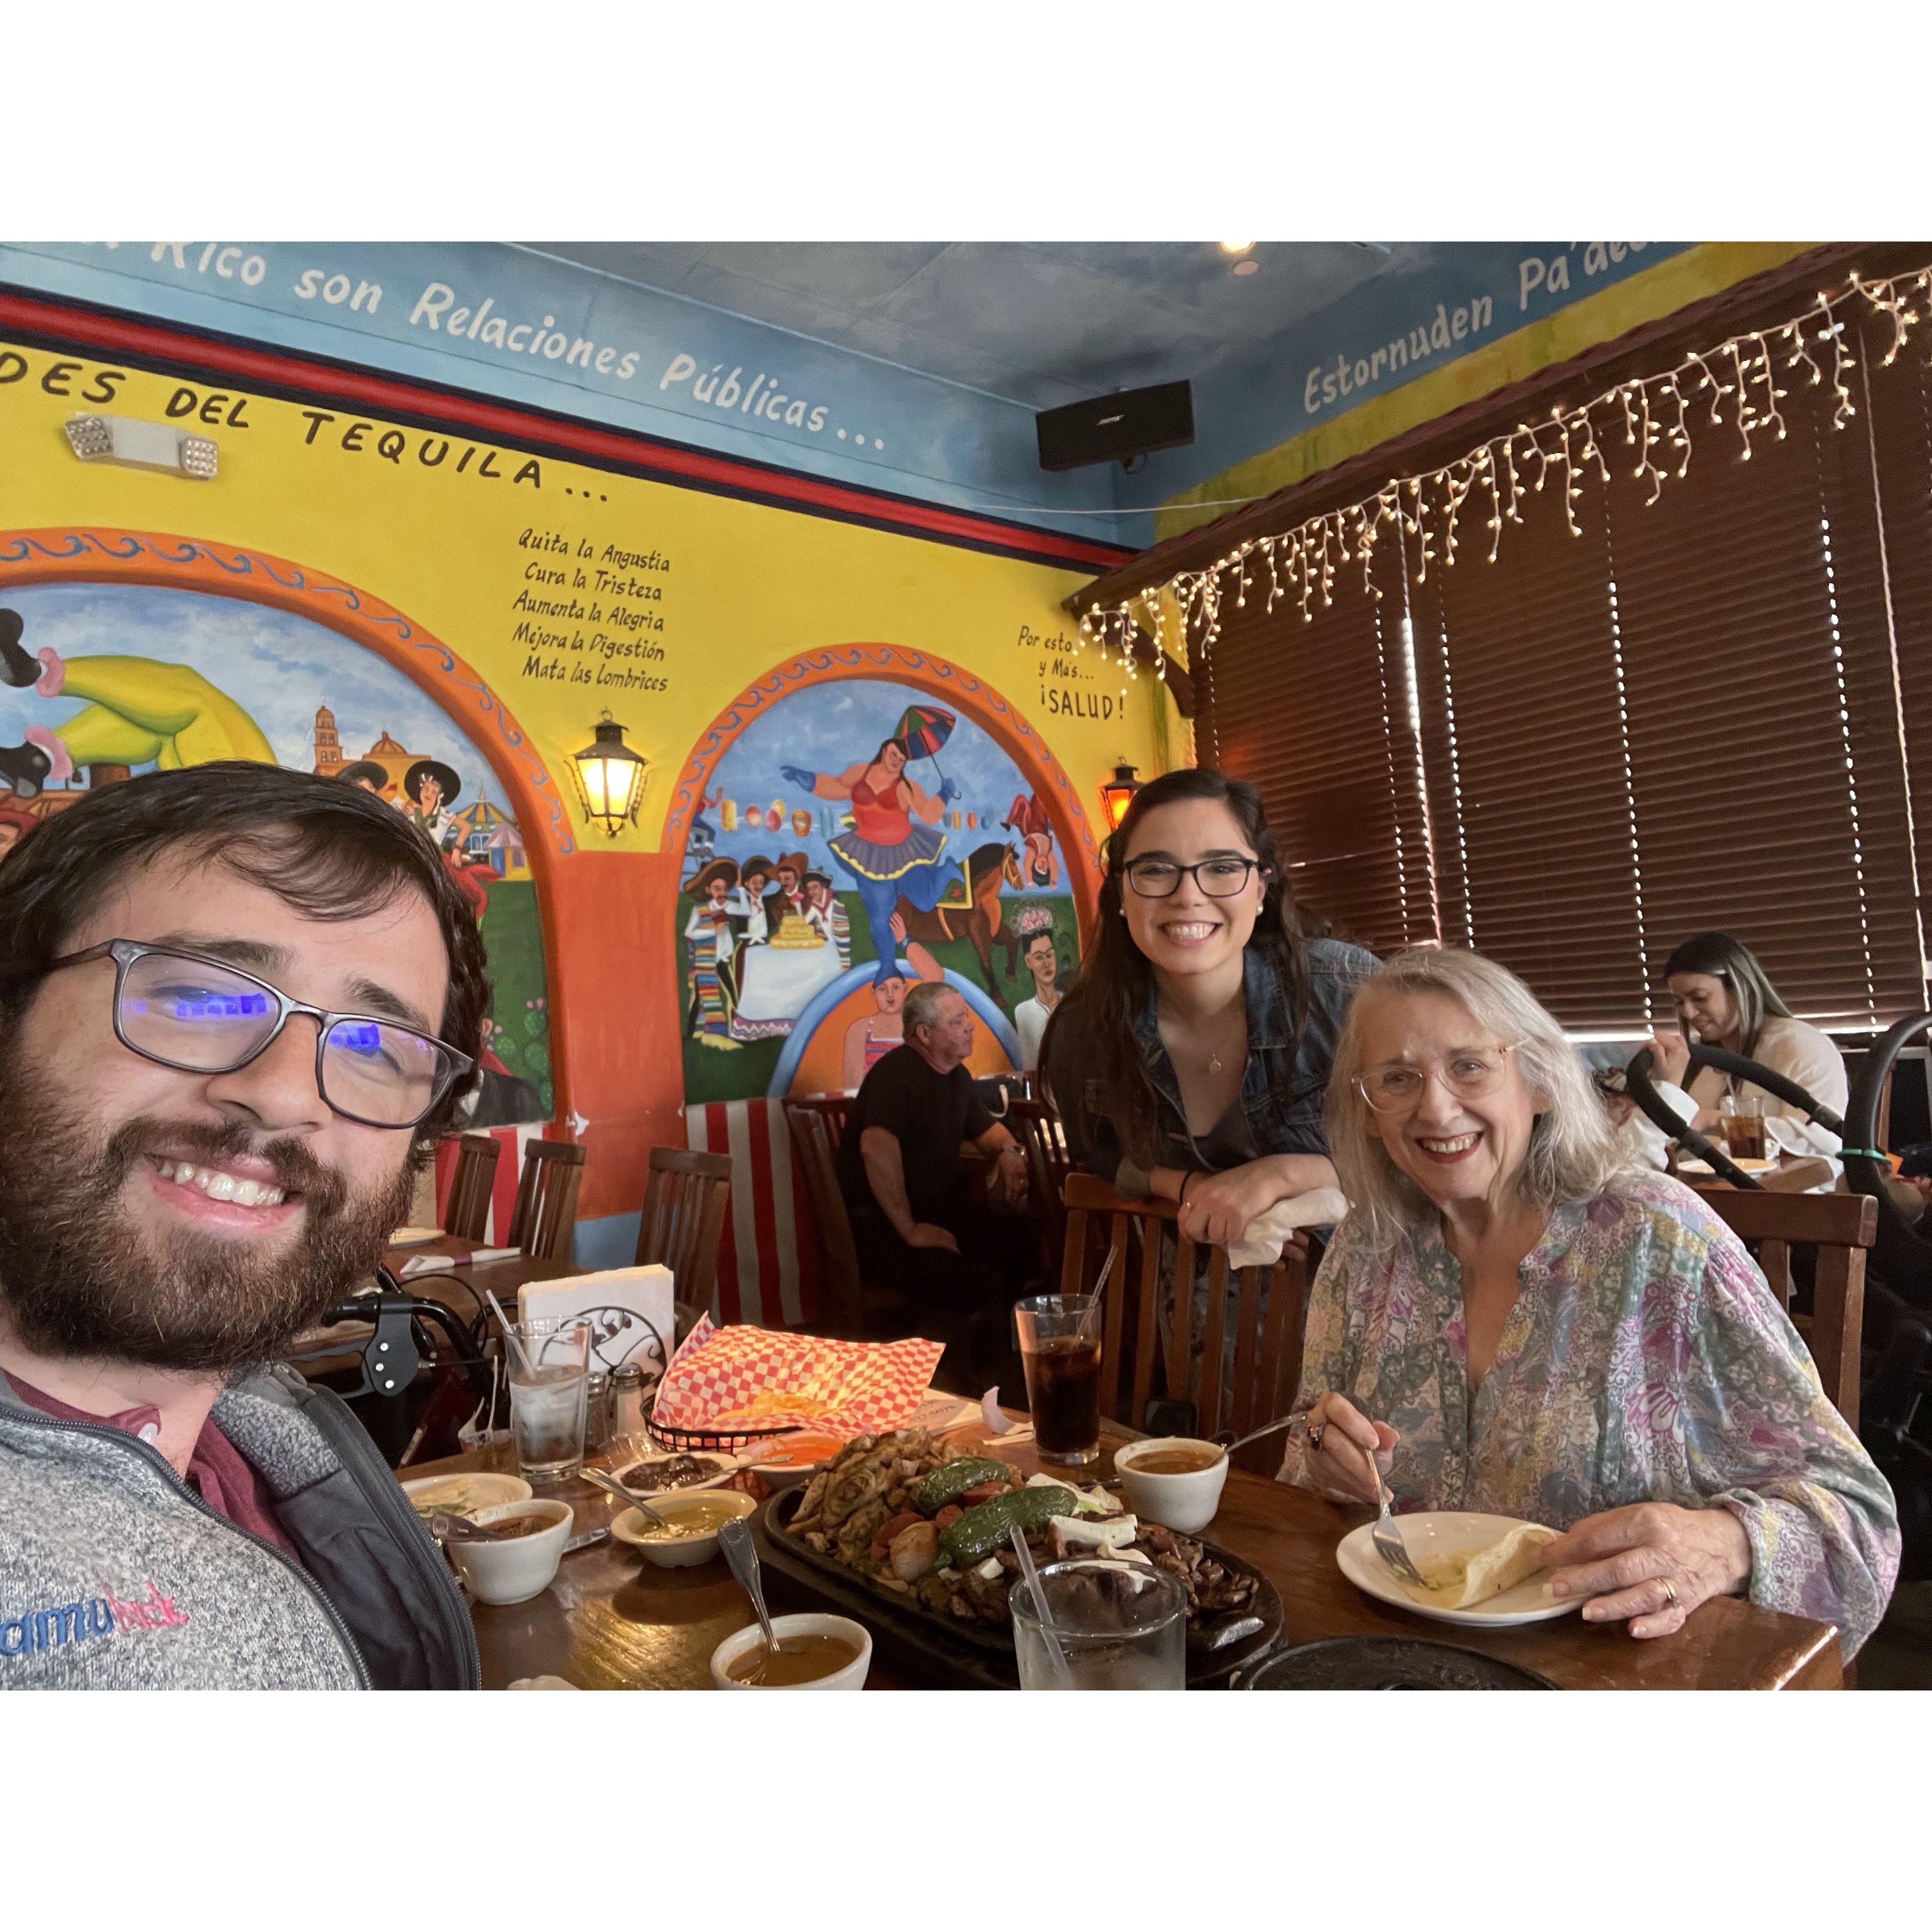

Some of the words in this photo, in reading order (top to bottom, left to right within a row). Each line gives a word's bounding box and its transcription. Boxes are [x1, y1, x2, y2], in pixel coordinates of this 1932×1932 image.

[293, 269, 383, 314] son
[410, 282, 640, 379] Relaciones
[1304, 295, 1493, 414] Estornuden
[165, 387, 250, 428] DEL
[518, 528, 569, 555] Quita
[577, 538, 594, 560] la
[601, 544, 670, 572] Angustia
[524, 562, 565, 585] Cura
[573, 568, 586, 589] la
[594, 570, 662, 601] Tristeza
[512, 589, 585, 620] Aumenta
[588, 602, 601, 622] la
[511, 622, 567, 651] Mejora
[570, 630, 584, 651] la
[589, 633, 665, 661] Digestión
[1018, 625, 1040, 646] Por
[1045, 632, 1072, 652] esto
[522, 655, 565, 681] Mata
[570, 661, 592, 684] las
[1039, 661, 1046, 678] y
